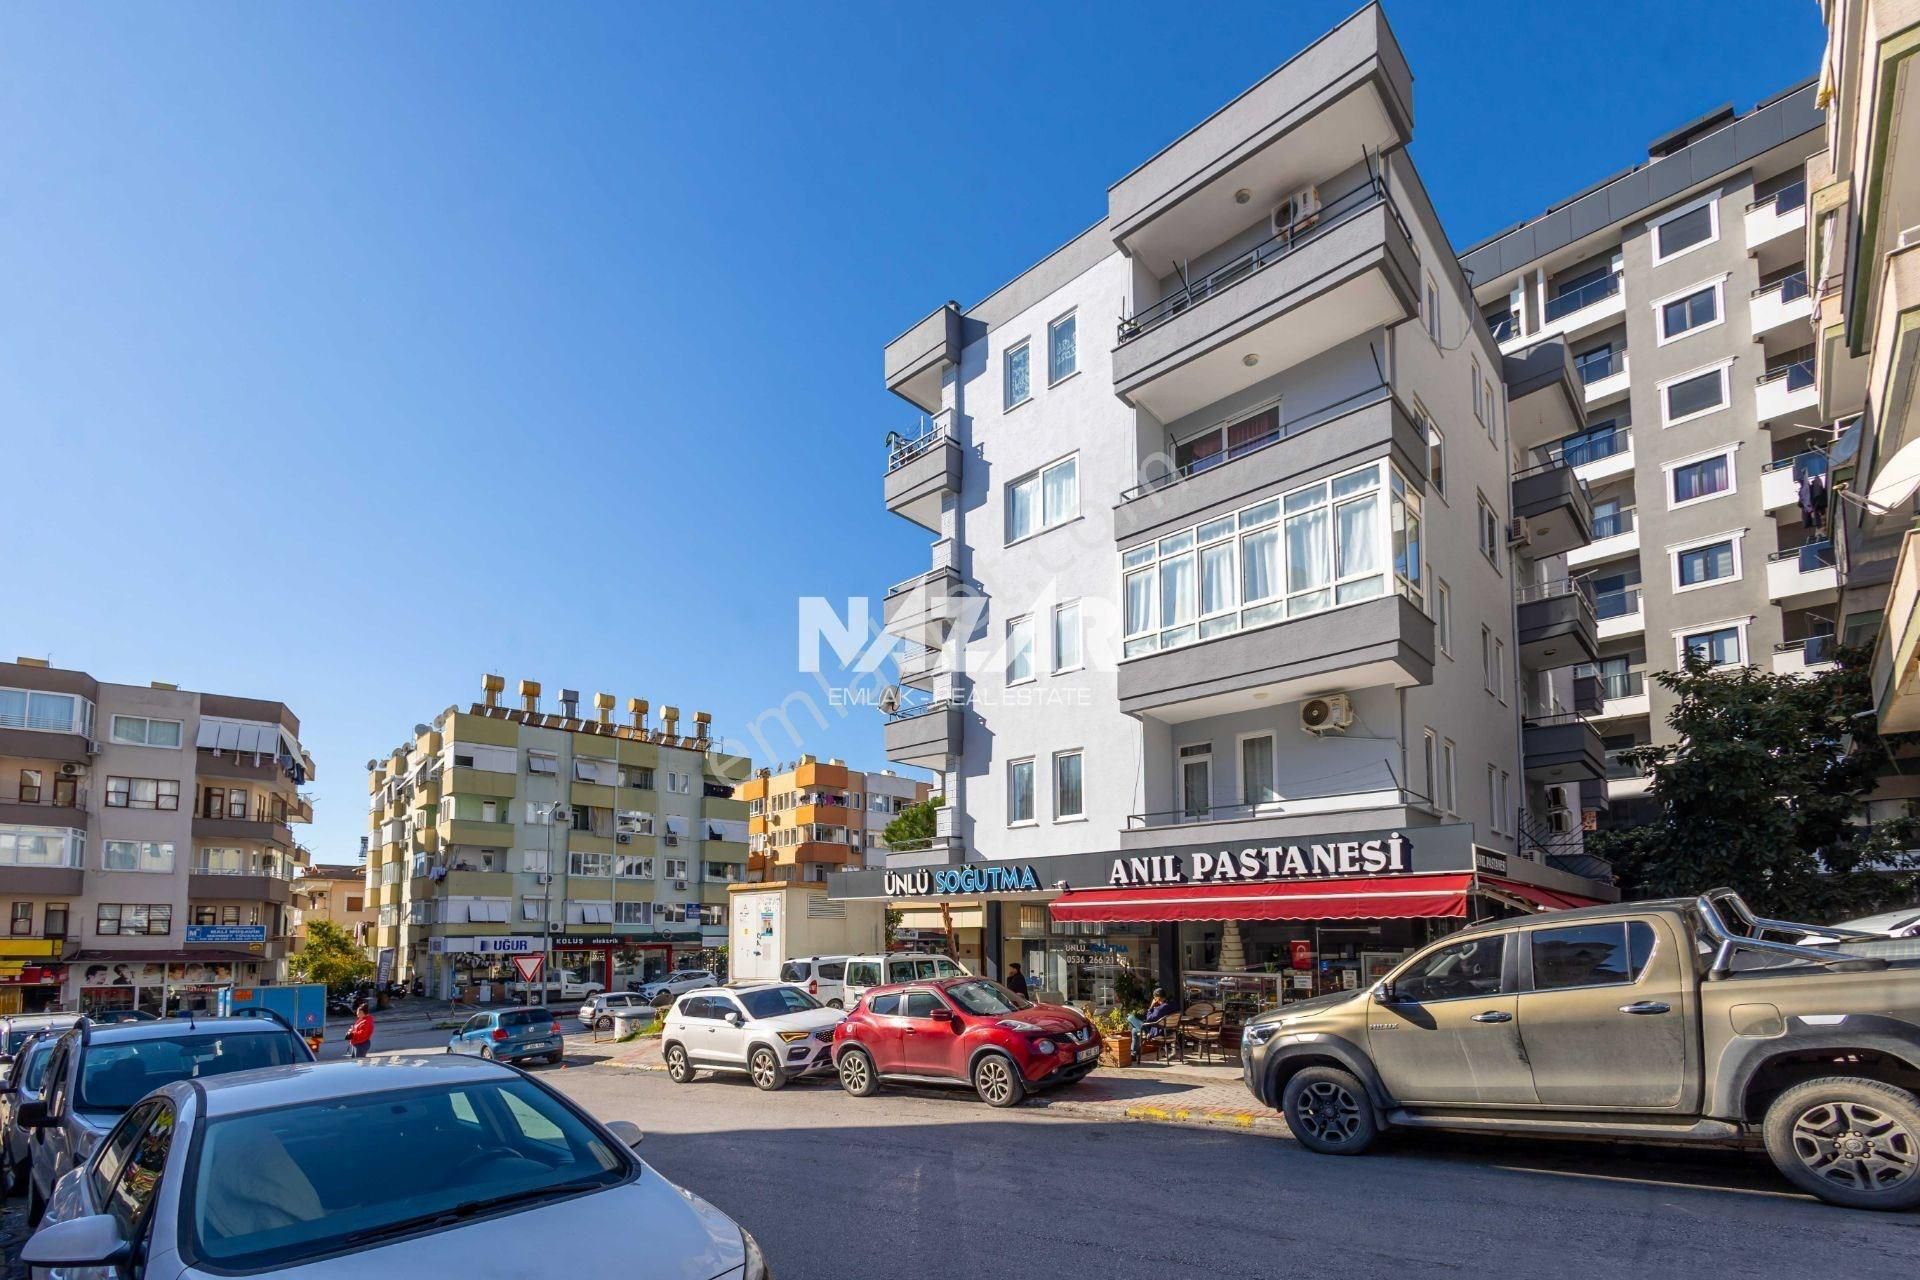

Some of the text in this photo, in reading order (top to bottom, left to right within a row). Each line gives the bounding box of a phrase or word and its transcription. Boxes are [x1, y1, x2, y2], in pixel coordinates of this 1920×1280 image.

[1109, 832, 1404, 885] ANIL PASTANESİ
[884, 864, 1037, 895] ÜNLÜ SOĞUTMA
[493, 938, 528, 951] UĞUR
[1066, 955, 1085, 964] 0536
